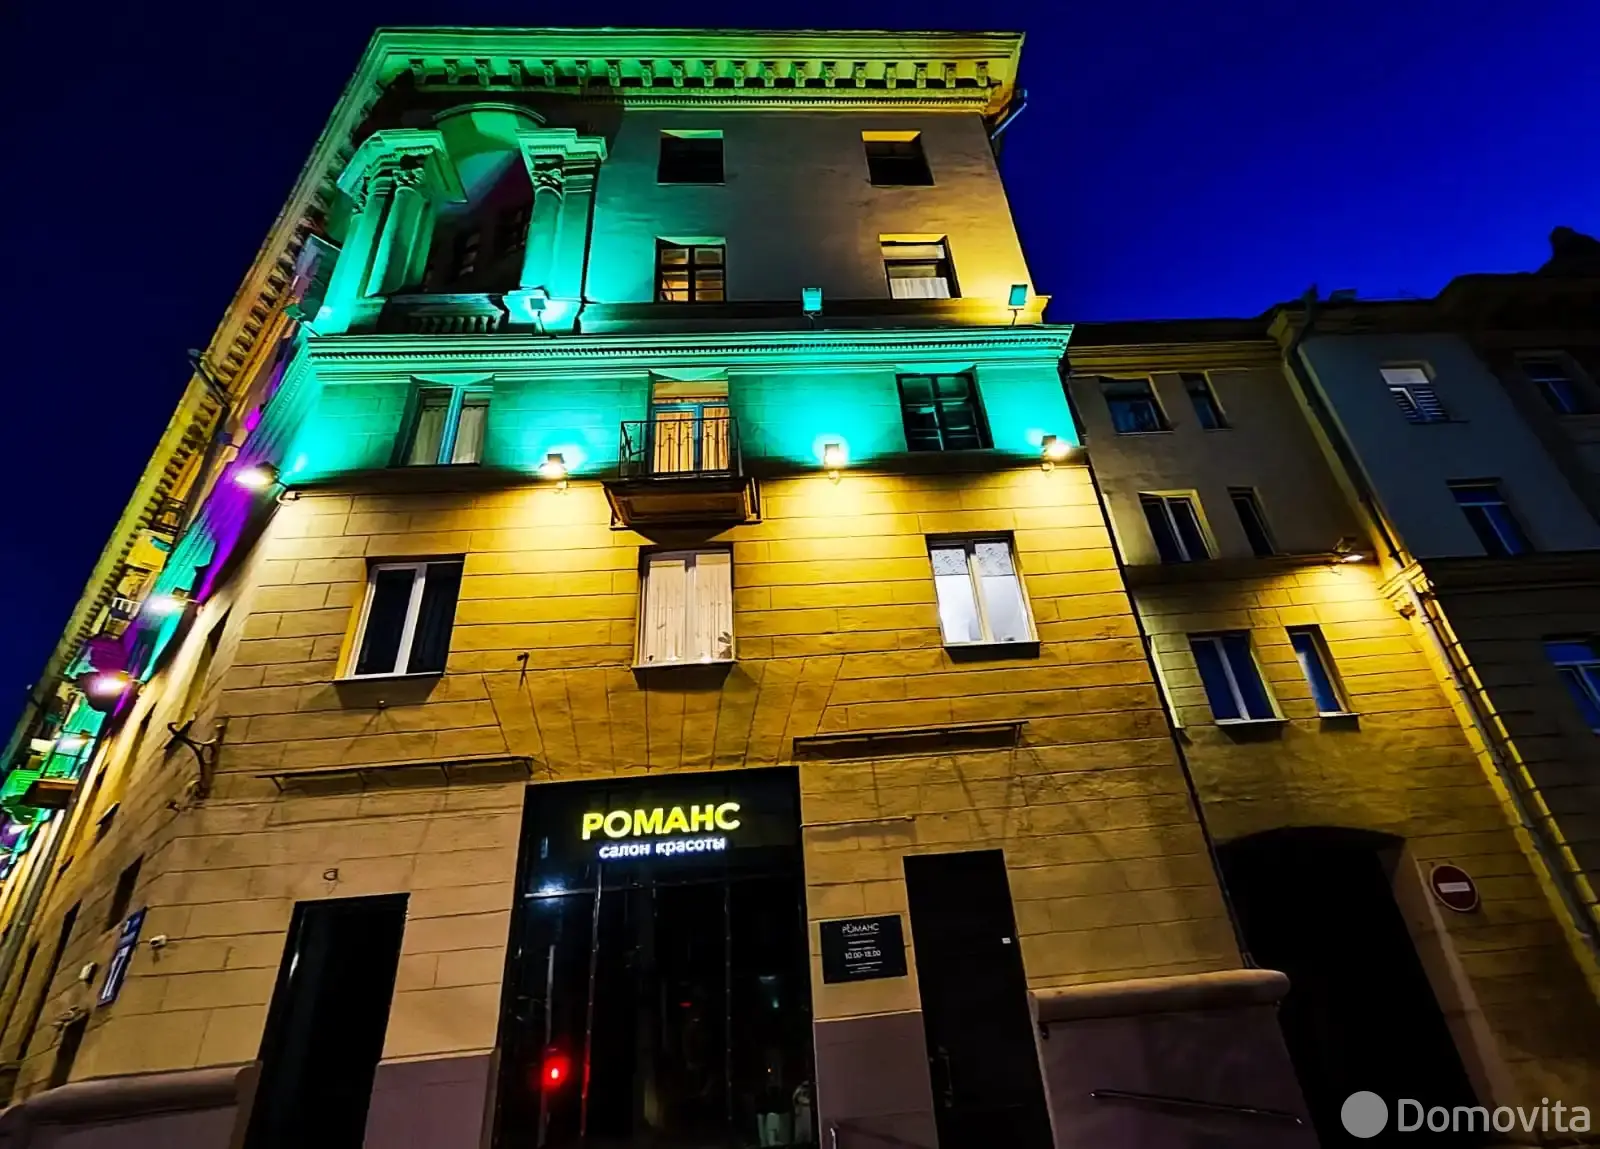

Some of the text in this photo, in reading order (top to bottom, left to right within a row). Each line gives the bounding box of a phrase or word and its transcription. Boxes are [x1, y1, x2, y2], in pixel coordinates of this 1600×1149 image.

[581, 802, 741, 841] РОМАНС
[599, 837, 726, 859] салон красоты
